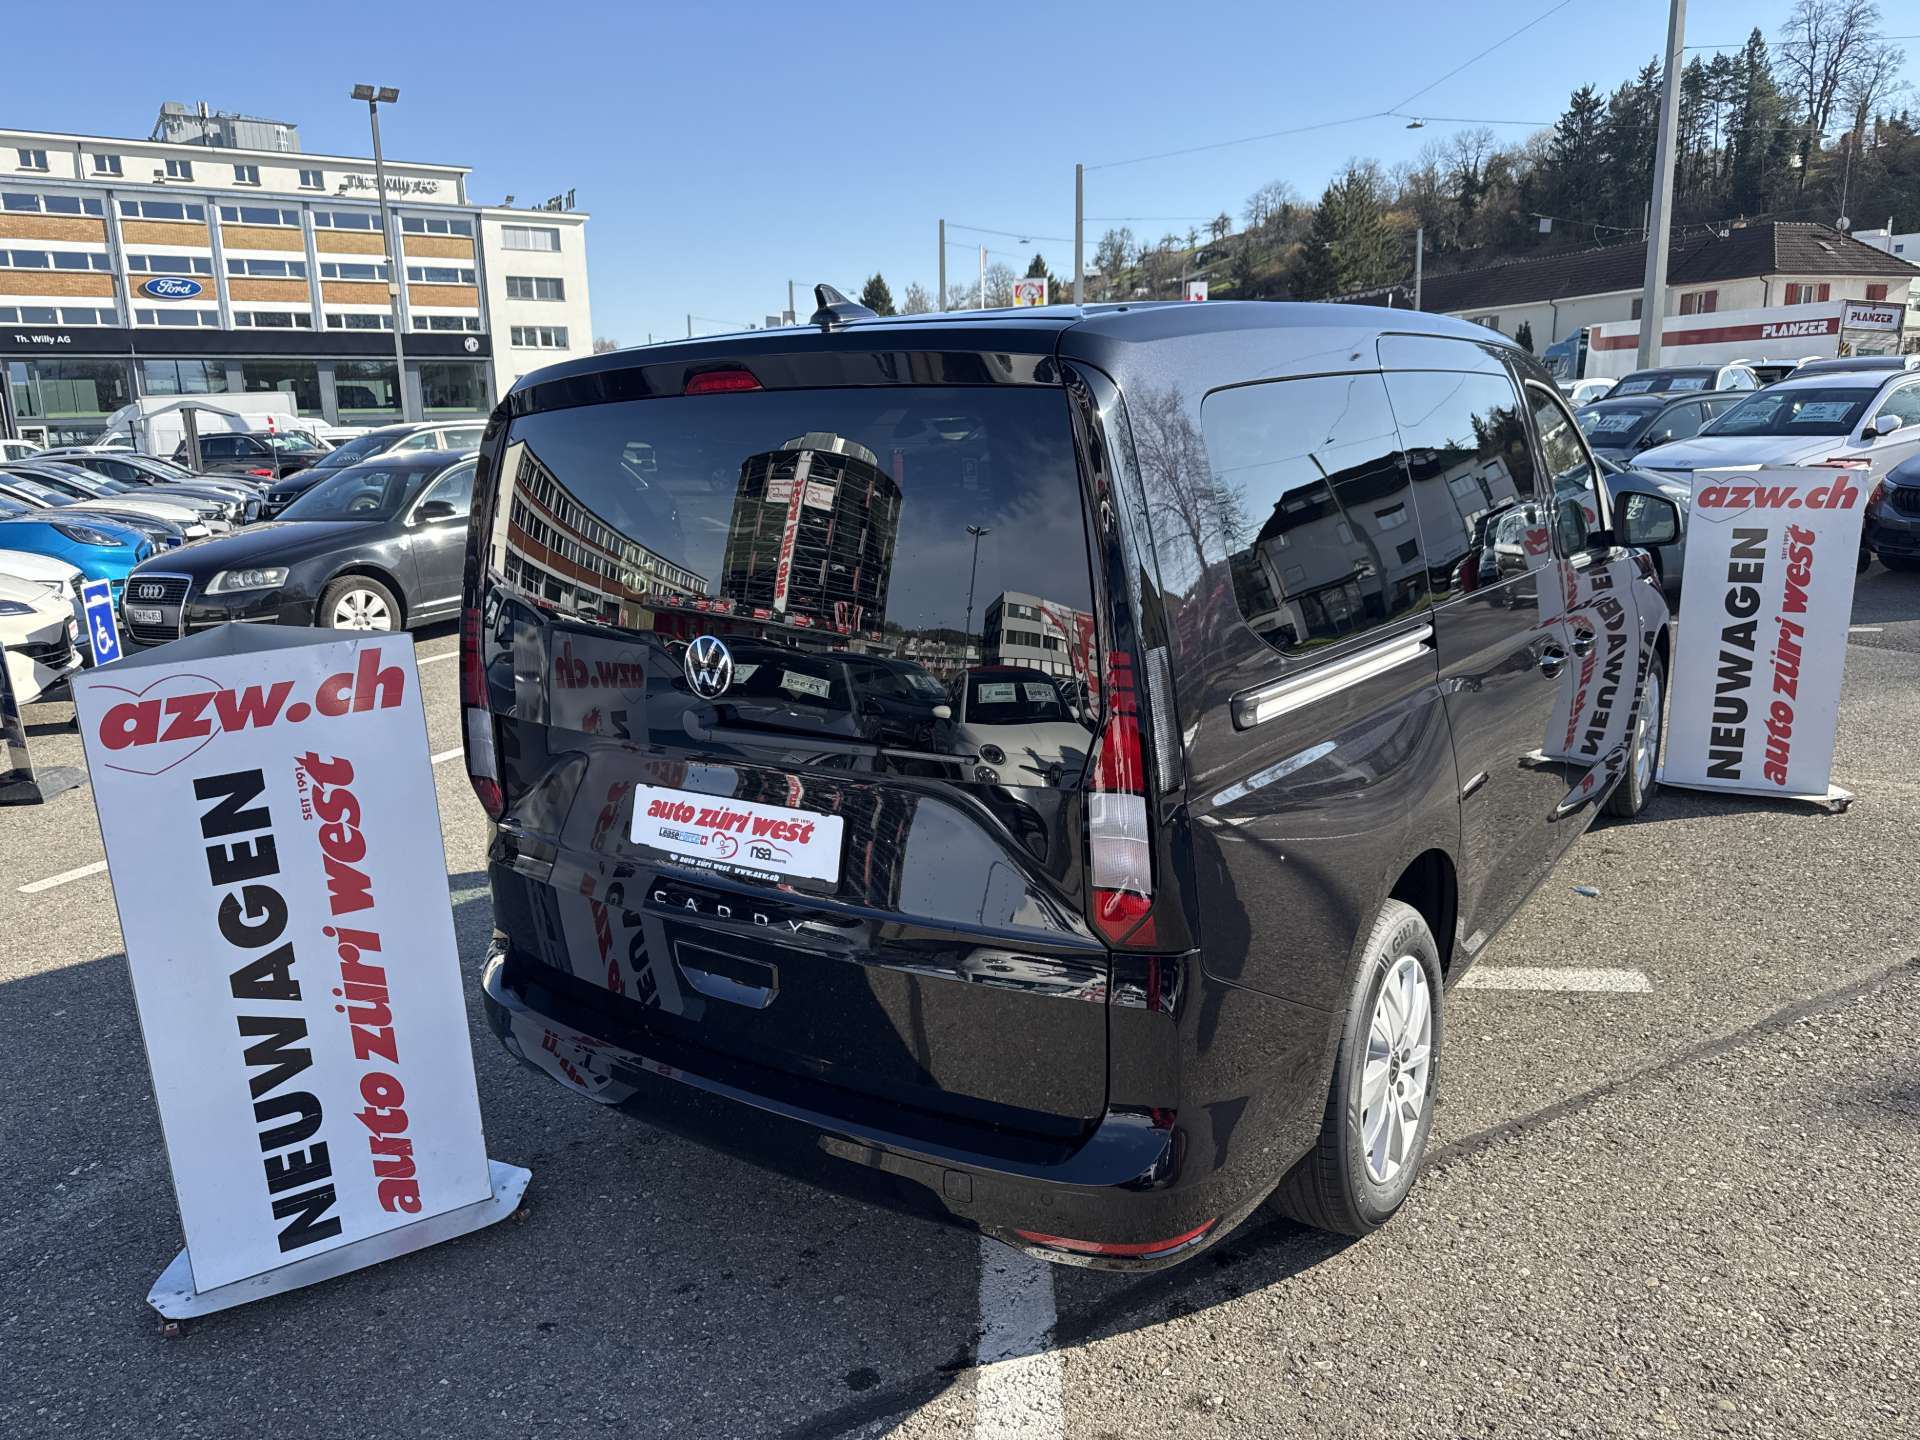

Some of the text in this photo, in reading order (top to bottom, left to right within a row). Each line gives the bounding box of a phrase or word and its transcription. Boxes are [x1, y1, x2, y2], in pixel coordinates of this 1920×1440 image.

[157, 279, 191, 294] Ford
[1761, 320, 1829, 338] PLANZER
[1851, 311, 1893, 324] PLANZER
[14, 335, 72, 345] Th. Willy AG
[1697, 475, 1859, 510] azw.ch
[1707, 528, 1769, 780] NEUWAGEN
[1763, 523, 1816, 786] auto züri west
[99, 647, 405, 750] azw.ch
[295, 766, 312, 821] SEIT 1991
[647, 799, 815, 844] auto züri west
[679, 856, 696, 866] auto
[713, 861, 731, 873] west
[734, 867, 780, 882] www.azw.ch
[750, 844, 771, 860] nsa
[654, 890, 803, 934] CADDY
[1392, 923, 1411, 954] Giti
[293, 751, 423, 1214] auto züri west
[193, 768, 343, 1254] NEUWAGEN
